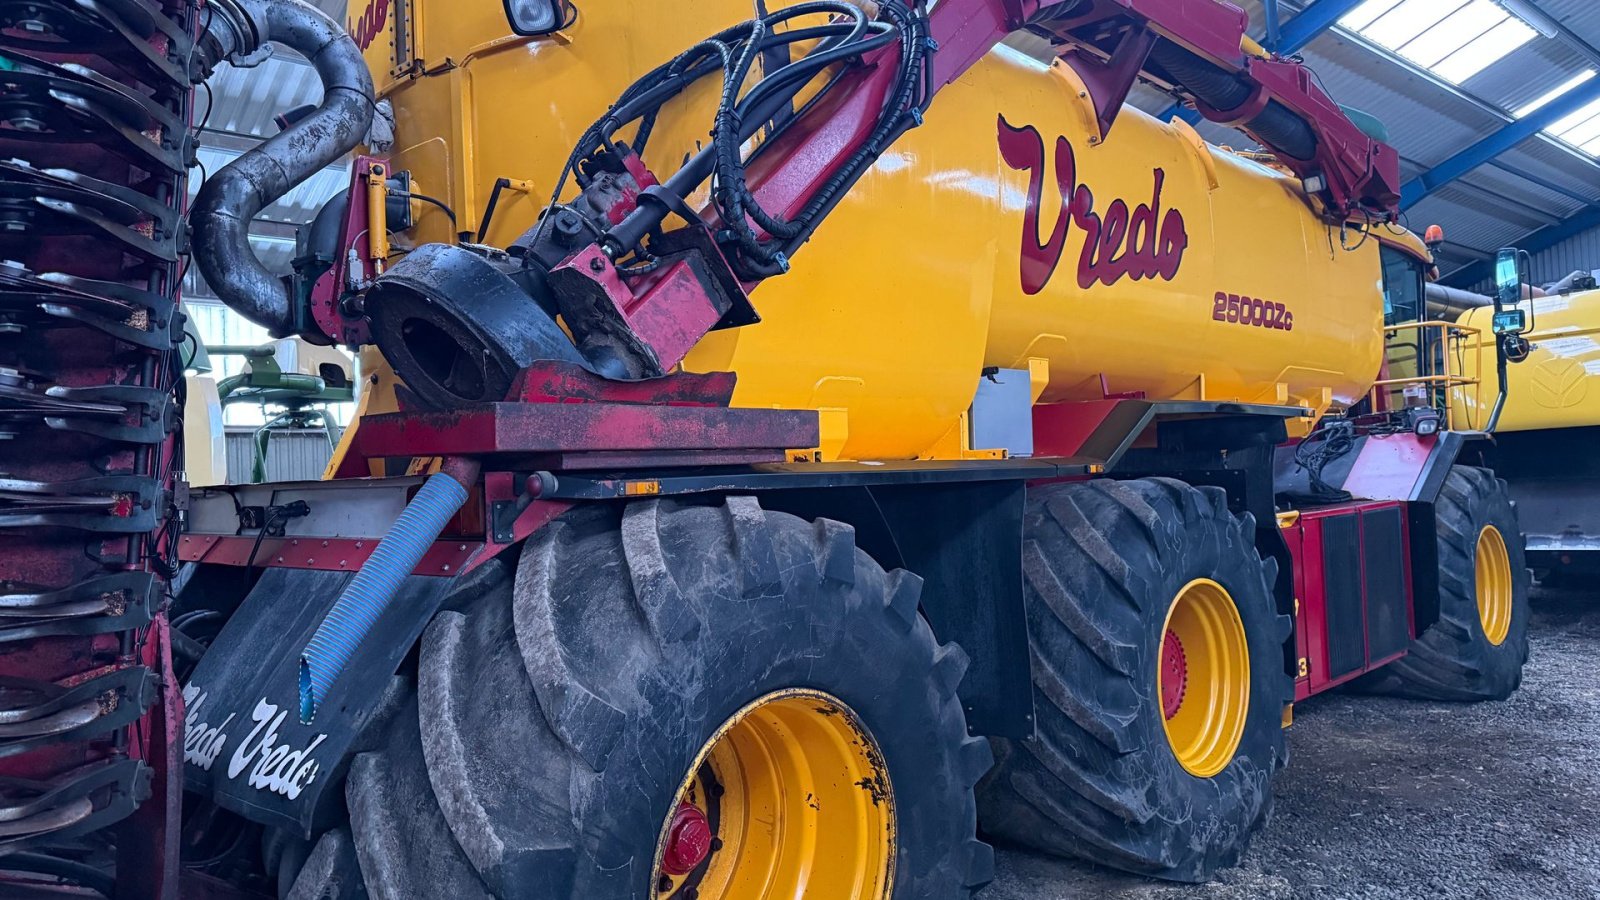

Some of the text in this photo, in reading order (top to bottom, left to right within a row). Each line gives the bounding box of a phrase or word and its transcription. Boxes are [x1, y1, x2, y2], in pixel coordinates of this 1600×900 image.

[346, 0, 389, 54] redo
[997, 113, 1187, 295] Vredo
[228, 697, 328, 800] Vredo
